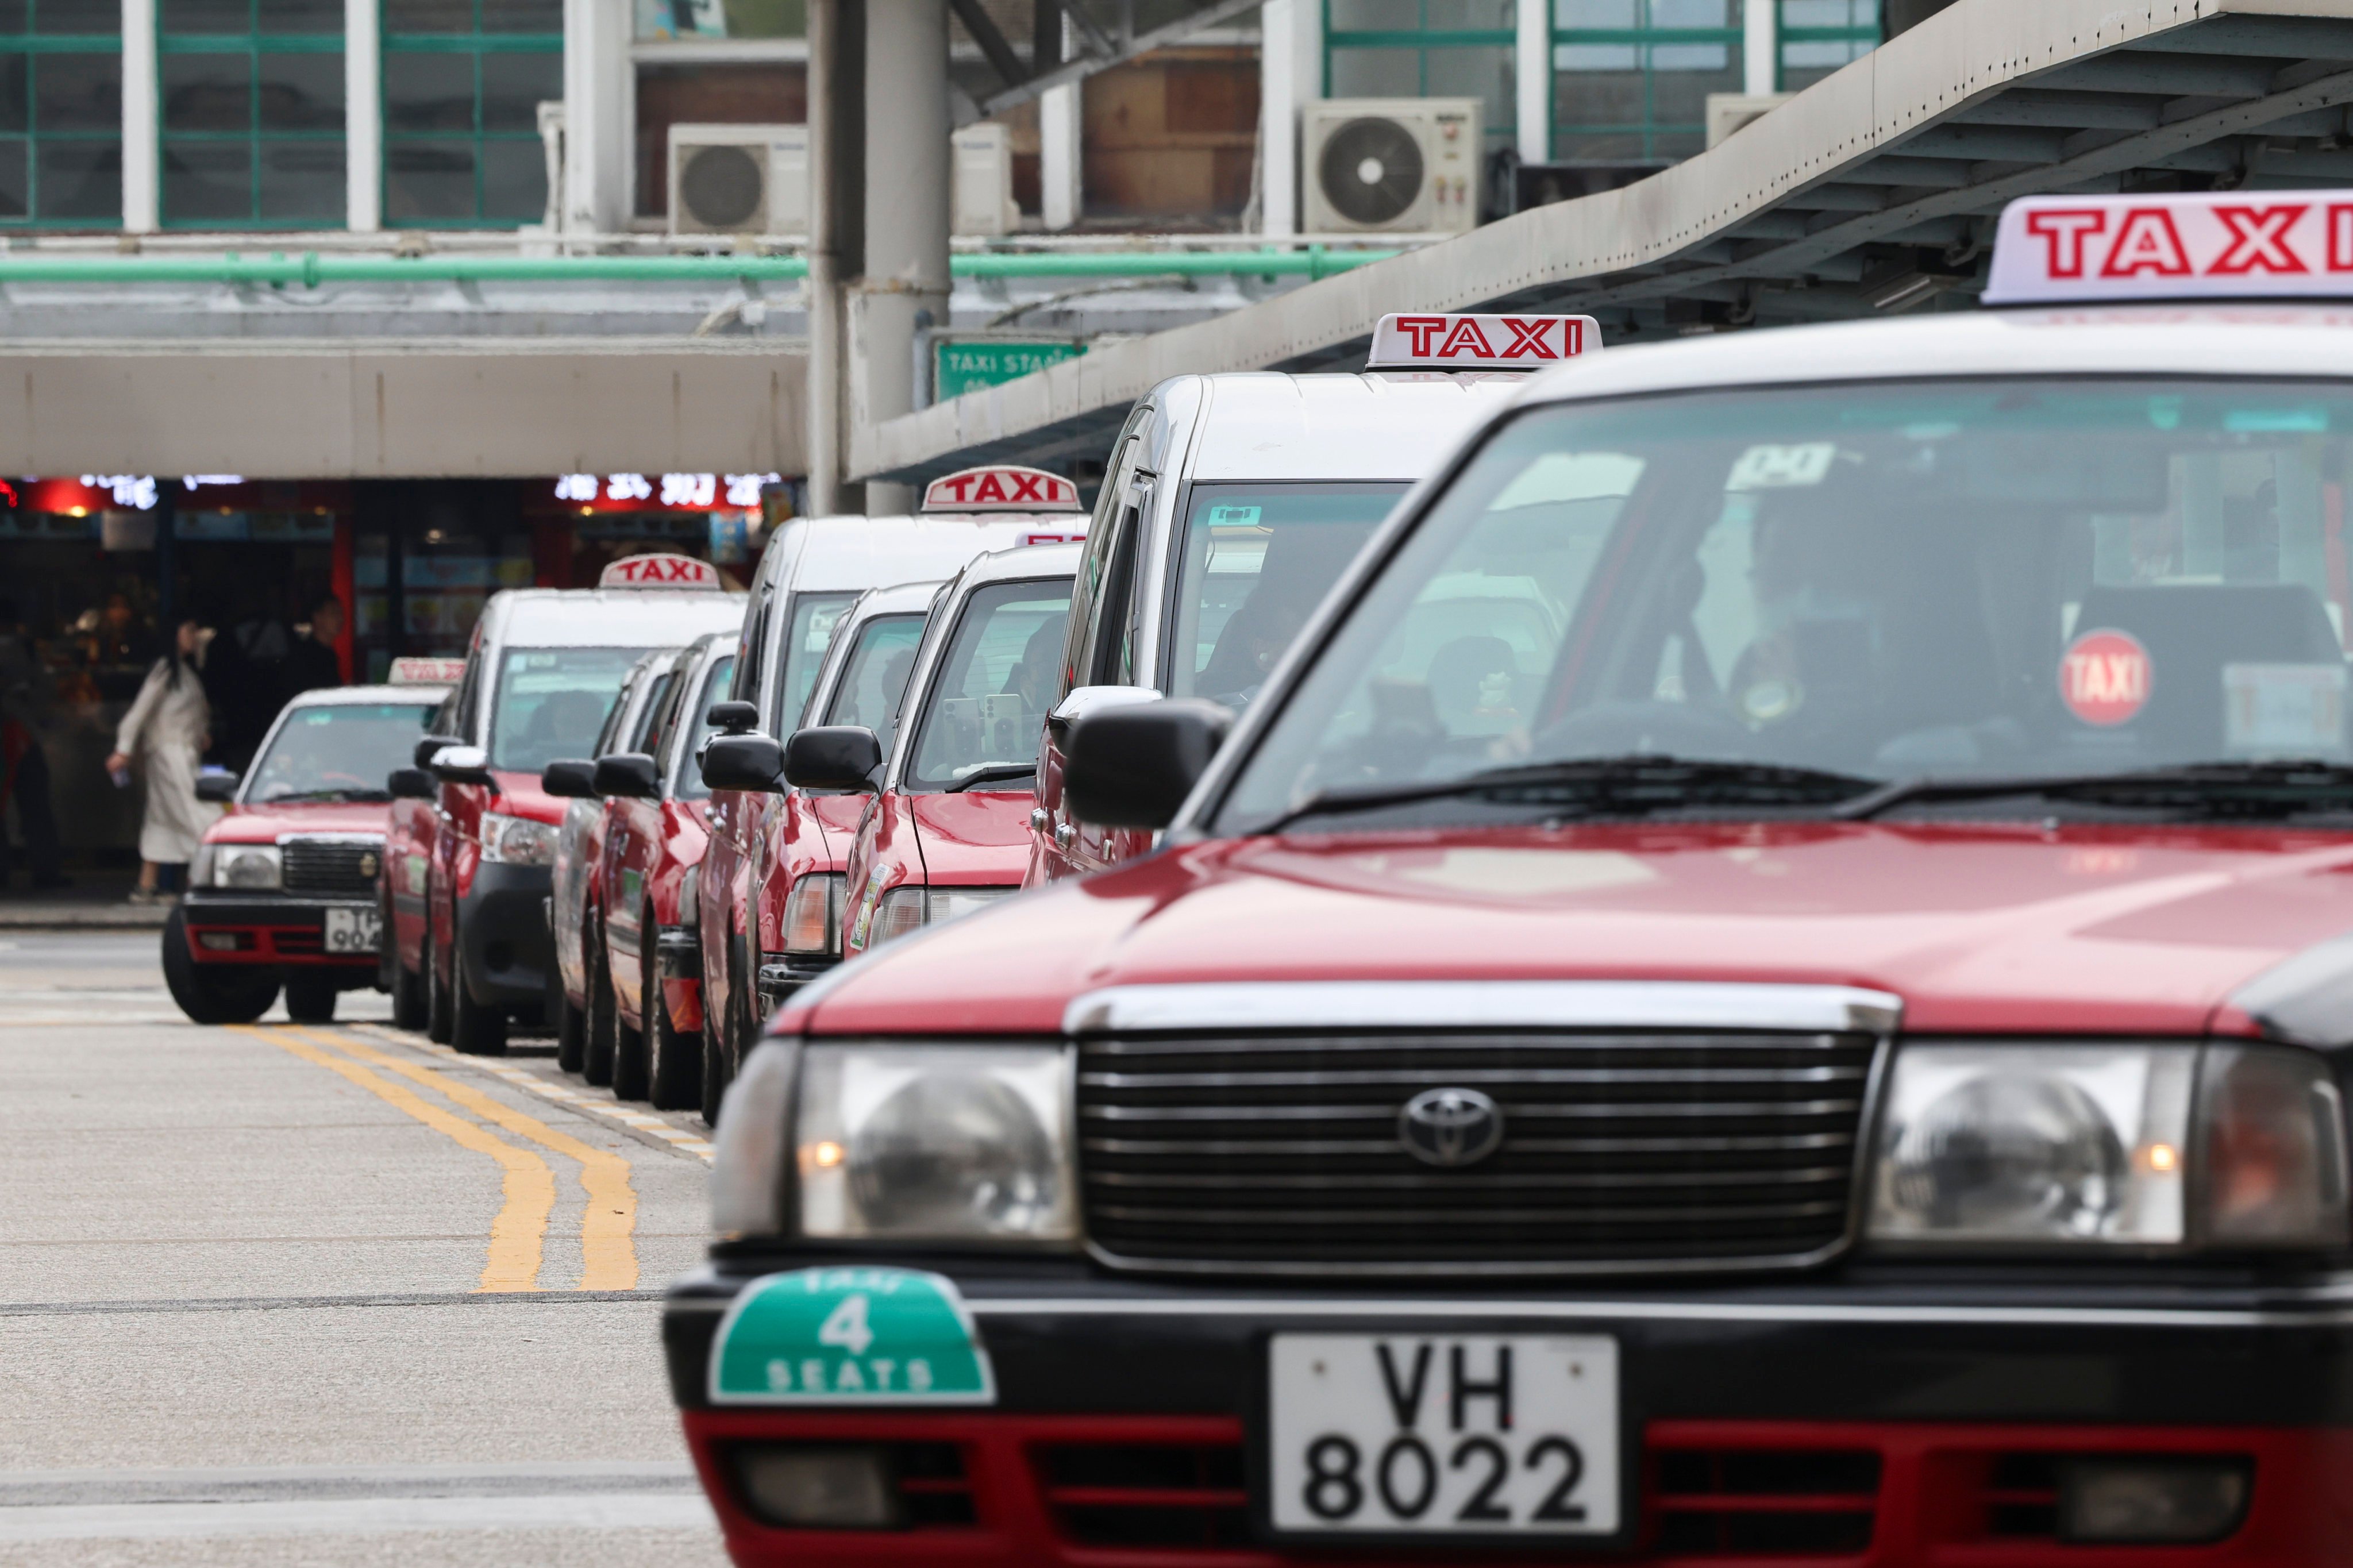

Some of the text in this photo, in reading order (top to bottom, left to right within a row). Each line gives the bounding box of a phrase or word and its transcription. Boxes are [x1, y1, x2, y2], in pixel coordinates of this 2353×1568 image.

[2027, 204, 2353, 280] TAXI
[1397, 317, 1582, 359] TAXI
[949, 353, 996, 373] TAXI
[945, 472, 1058, 502] TAXI
[618, 557, 703, 581] TAXI
[398, 662, 468, 680] TAX
[2066, 653, 2145, 703] TAXI
[818, 1293, 874, 1355] 4
[766, 1358, 933, 1394] SEATS
[1376, 1343, 1514, 1432] VH
[1301, 1435, 1588, 1521] 8022
